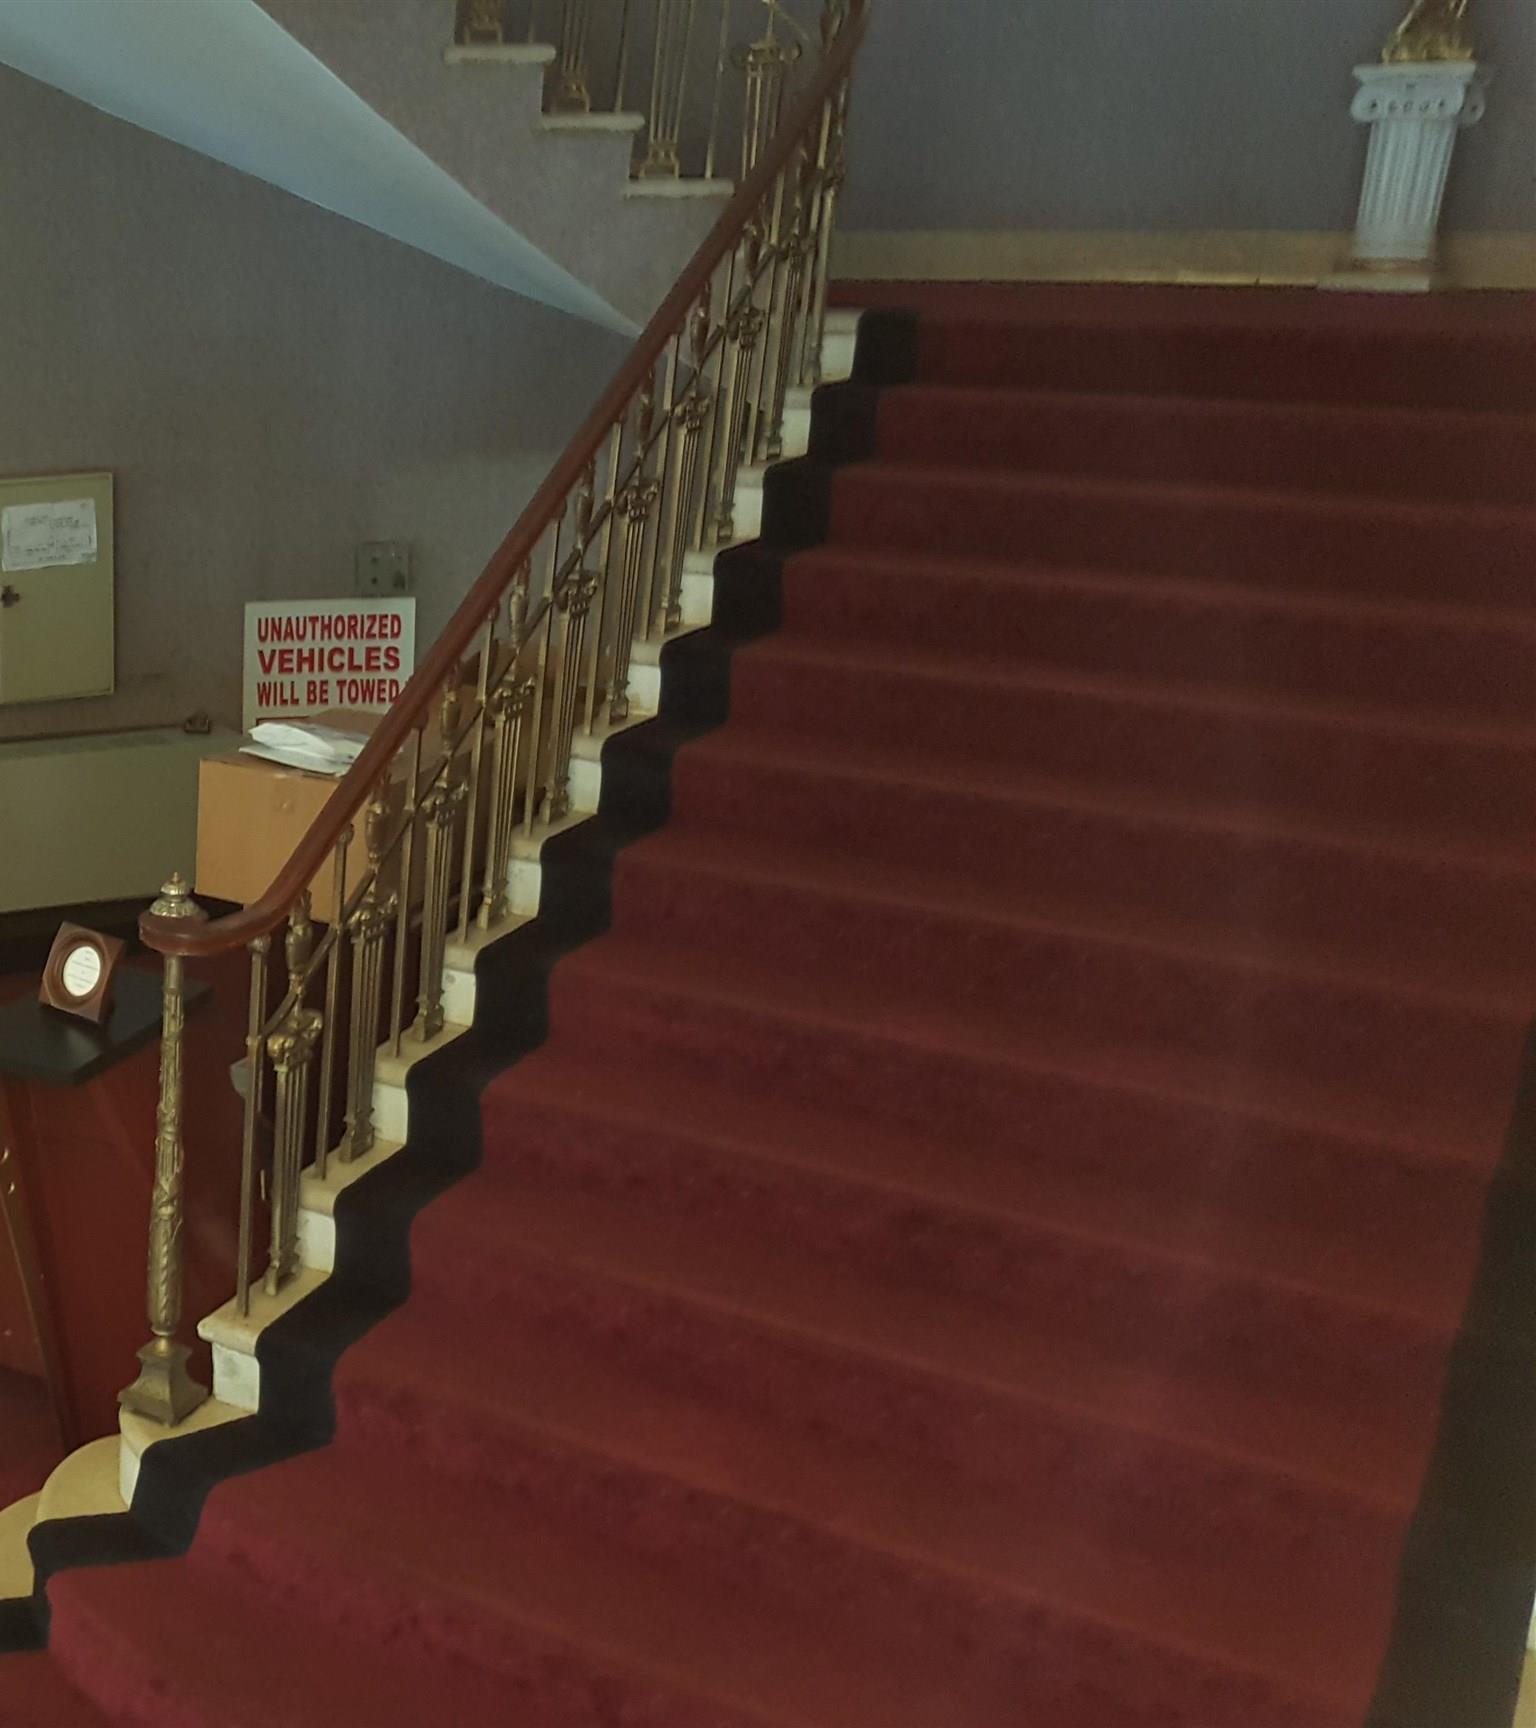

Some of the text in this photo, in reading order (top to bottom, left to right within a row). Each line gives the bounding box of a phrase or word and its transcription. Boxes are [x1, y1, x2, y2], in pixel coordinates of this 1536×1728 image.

[257, 614, 402, 643] UNAUTHORIZED
[257, 646, 401, 675] VEHICLES
[257, 678, 400, 707] WILL BE TOWED
